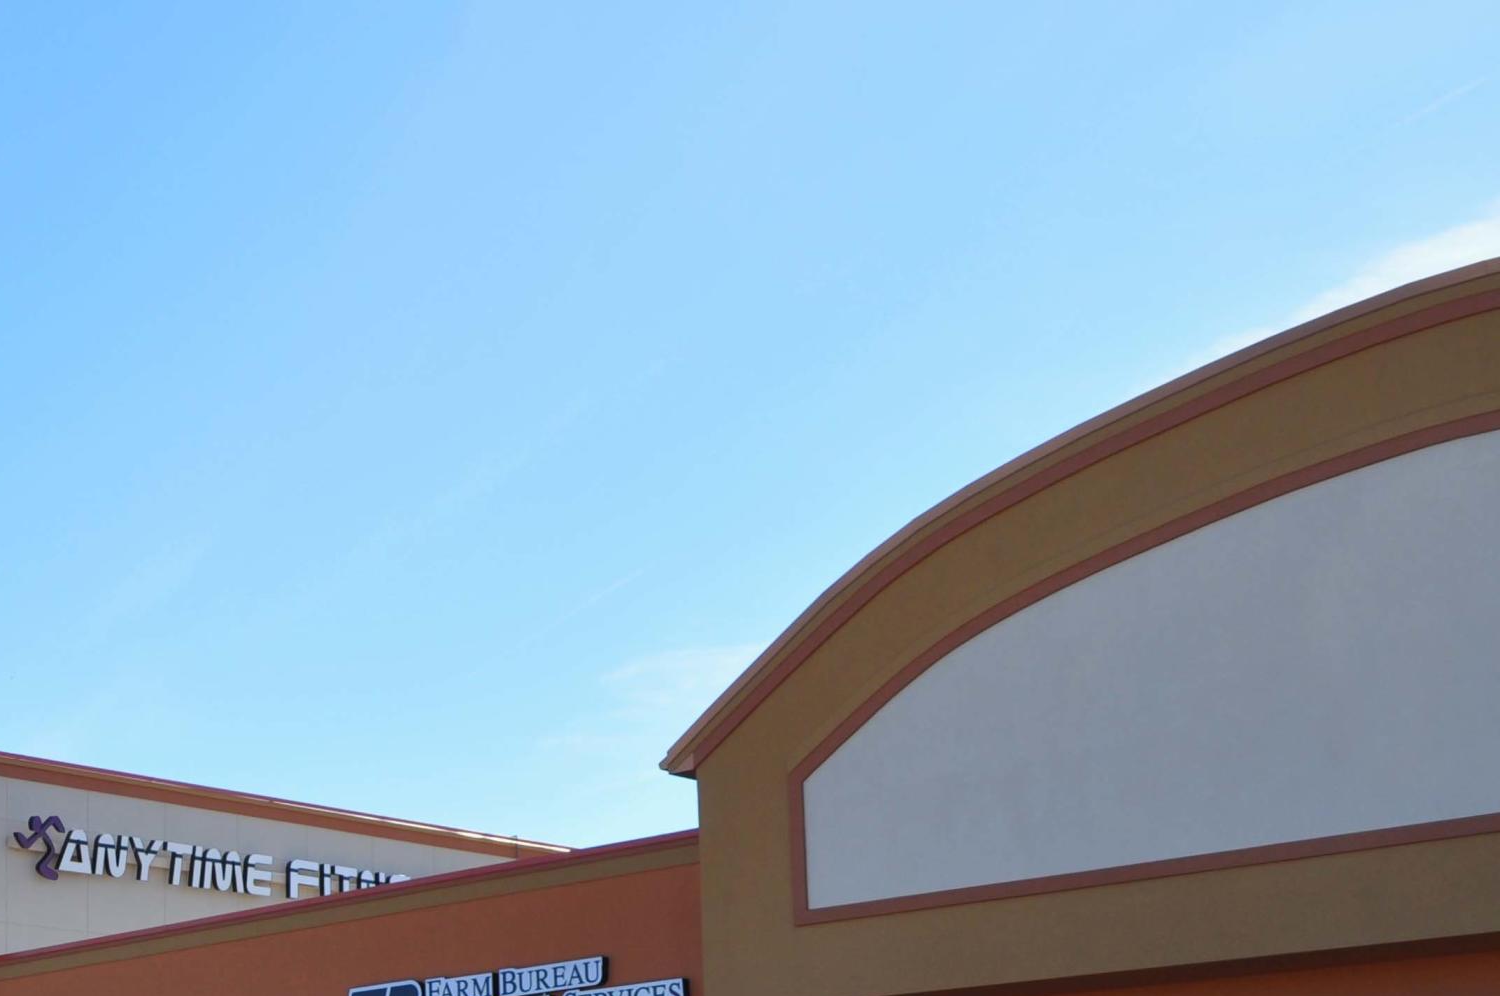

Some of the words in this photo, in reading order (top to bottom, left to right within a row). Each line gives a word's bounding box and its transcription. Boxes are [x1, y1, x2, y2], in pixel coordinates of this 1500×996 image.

[56, 829, 273, 896] ANYTIME
[287, 859, 411, 899] FITN
[500, 960, 600, 996] BUREAU
